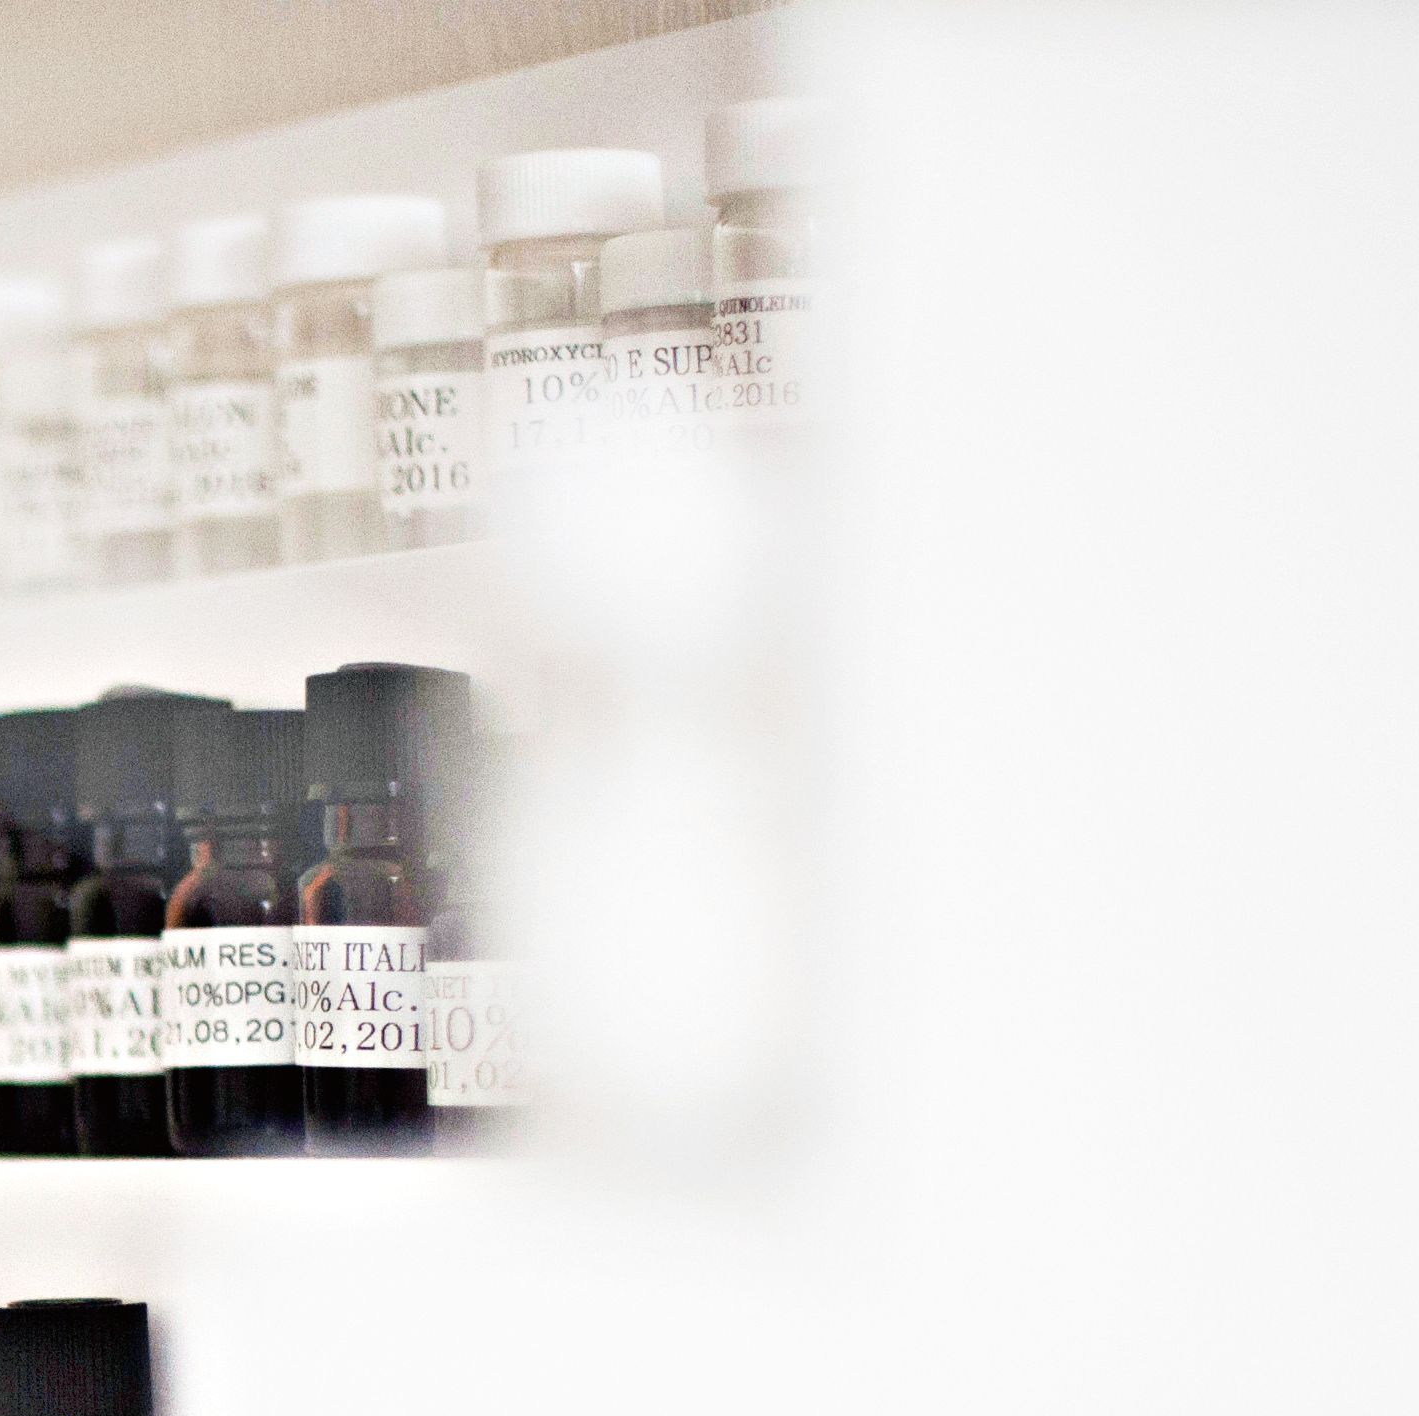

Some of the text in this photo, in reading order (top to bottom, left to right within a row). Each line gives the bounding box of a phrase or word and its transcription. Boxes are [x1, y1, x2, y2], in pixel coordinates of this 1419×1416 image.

[627, 348, 645, 380] E
[653, 343, 714, 376] SUP
[392, 460, 471, 494] 2016
[219, 942, 289, 968] RES.
